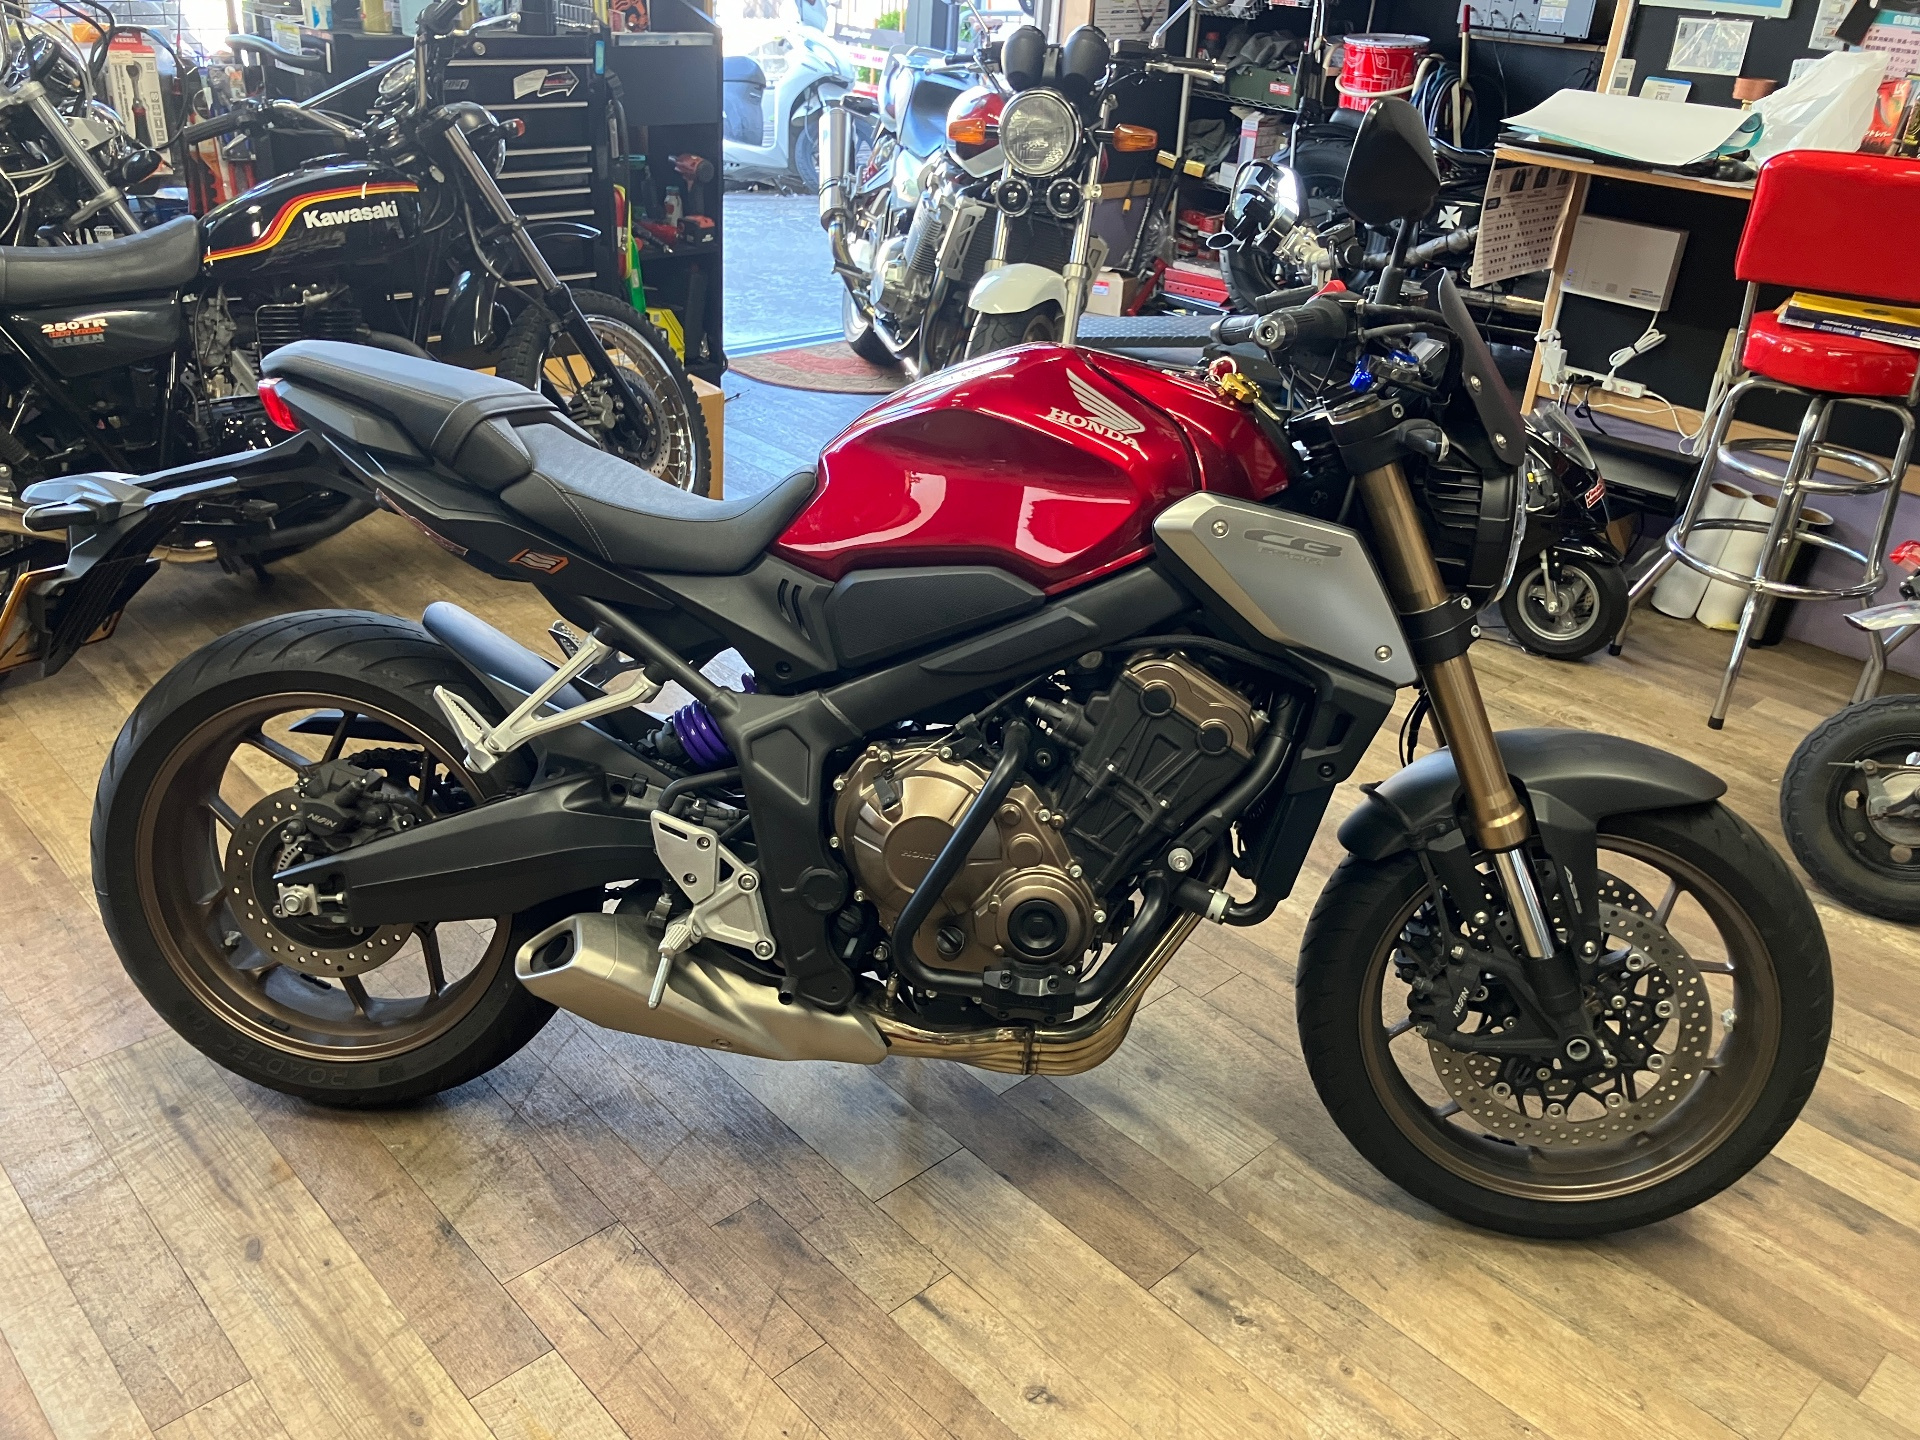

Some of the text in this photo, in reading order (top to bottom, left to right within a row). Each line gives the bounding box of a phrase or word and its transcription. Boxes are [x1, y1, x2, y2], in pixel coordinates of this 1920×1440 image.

[114, 36, 138, 44] VESSEL
[302, 200, 399, 229] Kawasaki
[40, 318, 109, 334] 250TR
[1044, 406, 1146, 457] HONDA
[1243, 529, 1343, 558] CB
[307, 812, 338, 829] NISSIN
[901, 850, 937, 861] HOND
[1452, 986, 1470, 1018] NISSIN
